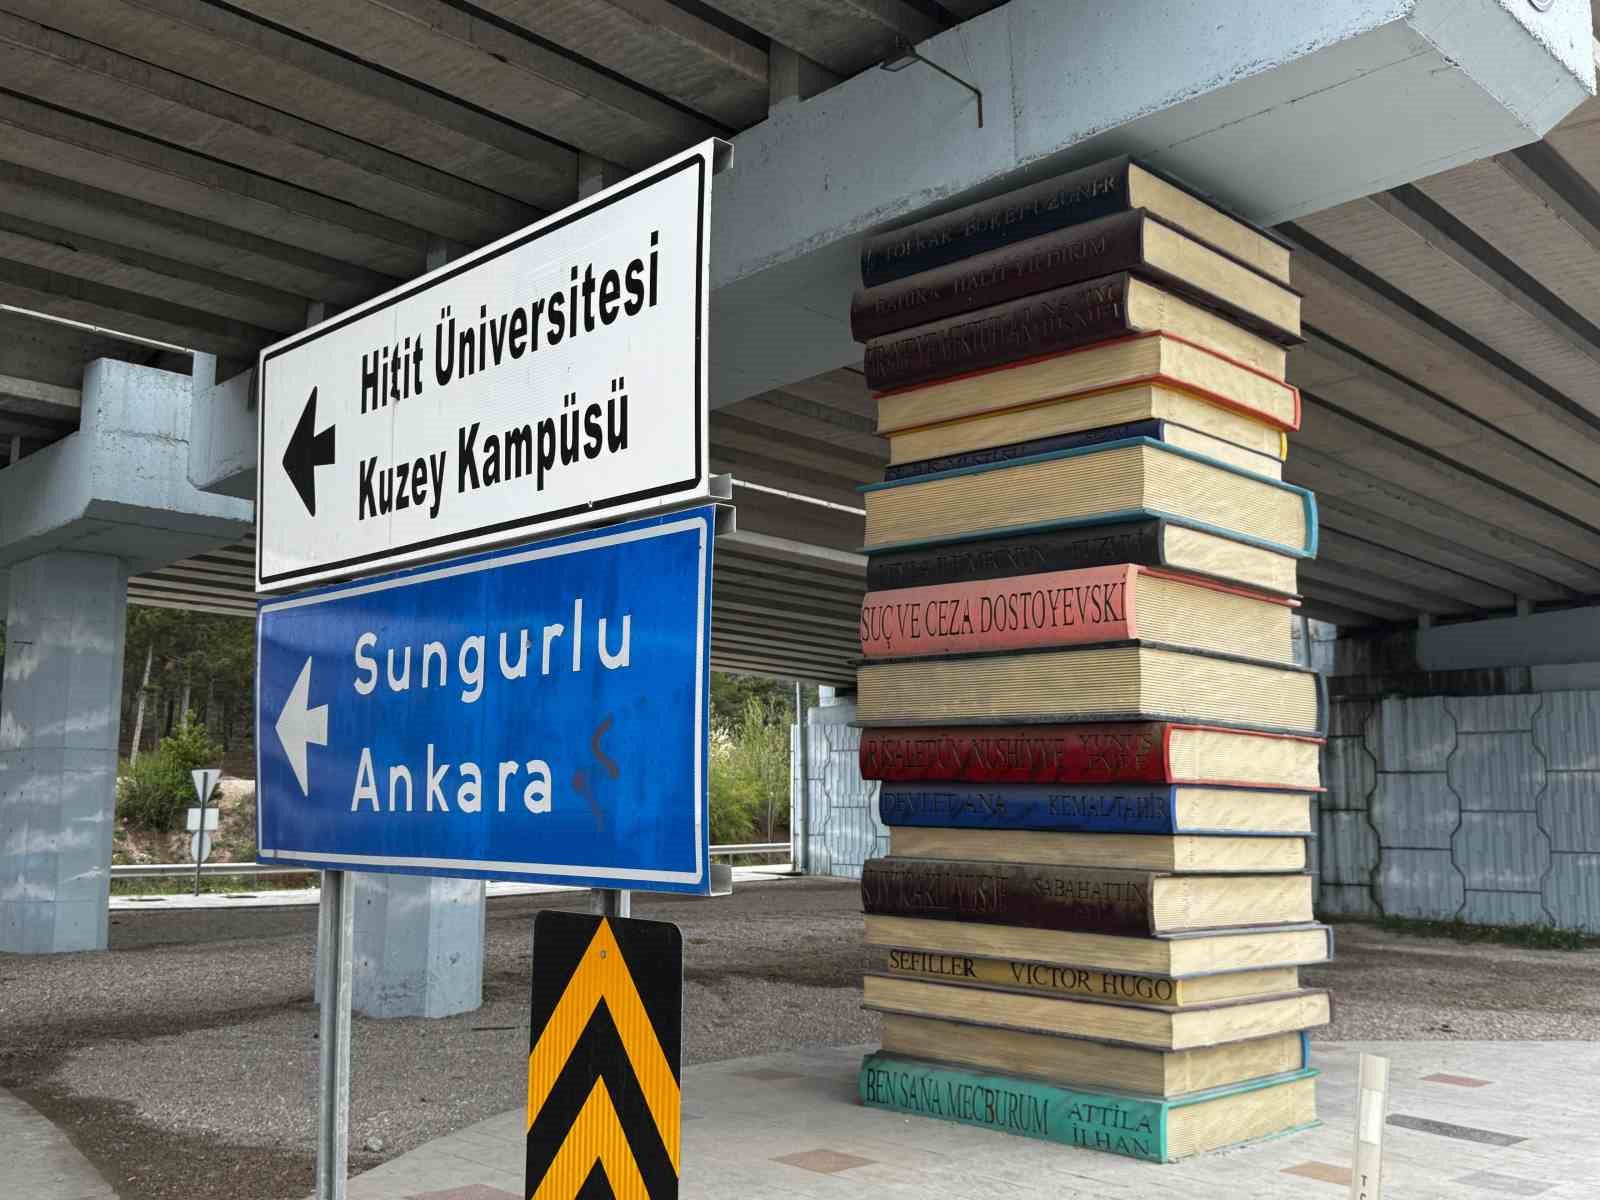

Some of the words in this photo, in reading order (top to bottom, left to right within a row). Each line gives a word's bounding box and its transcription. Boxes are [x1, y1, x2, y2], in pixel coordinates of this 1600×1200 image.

[360, 332, 423, 414] Hitit
[434, 230, 659, 387] Üniversitesi
[358, 448, 447, 521] Kuzey
[457, 376, 629, 492] Kampüsü
[862, 604, 893, 649] SUÇ
[897, 603, 920, 638] VE
[925, 596, 974, 637] CEZA
[980, 573, 1126, 633] DOSTOYEVSKİ
[353, 598, 631, 703] Sungurlu
[350, 743, 553, 814] Ankara
[1010, 962, 1093, 993] VICTOR
[1101, 974, 1173, 1000] HUGO
[866, 1068, 897, 1104] BEN
[900, 1072, 943, 1115] SANA
[944, 1081, 1049, 1135] MECBURUM
[1068, 1103, 1153, 1134] ATTİLA
